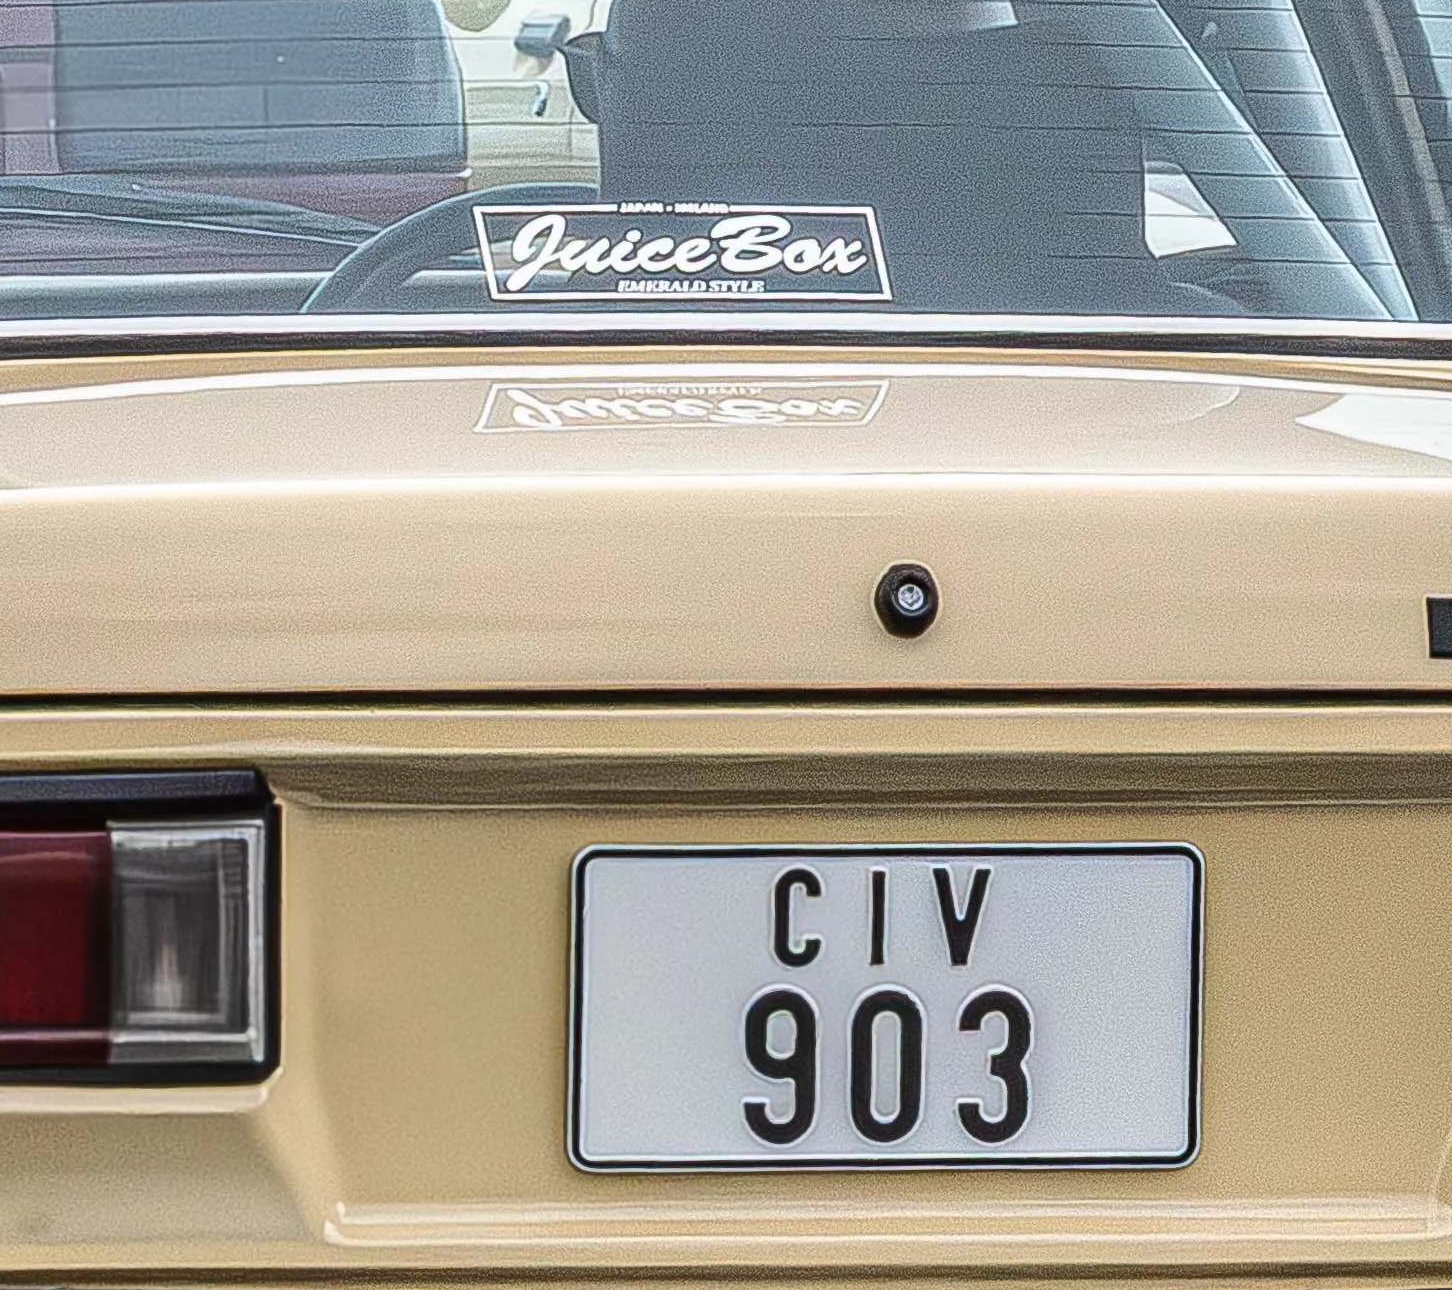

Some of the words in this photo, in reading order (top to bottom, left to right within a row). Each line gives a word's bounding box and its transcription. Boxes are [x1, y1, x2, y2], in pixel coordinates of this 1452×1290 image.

[617, 279, 707, 294] EMERALD
[708, 280, 766, 294] STYLE
[743, 989, 1033, 1145] 903
